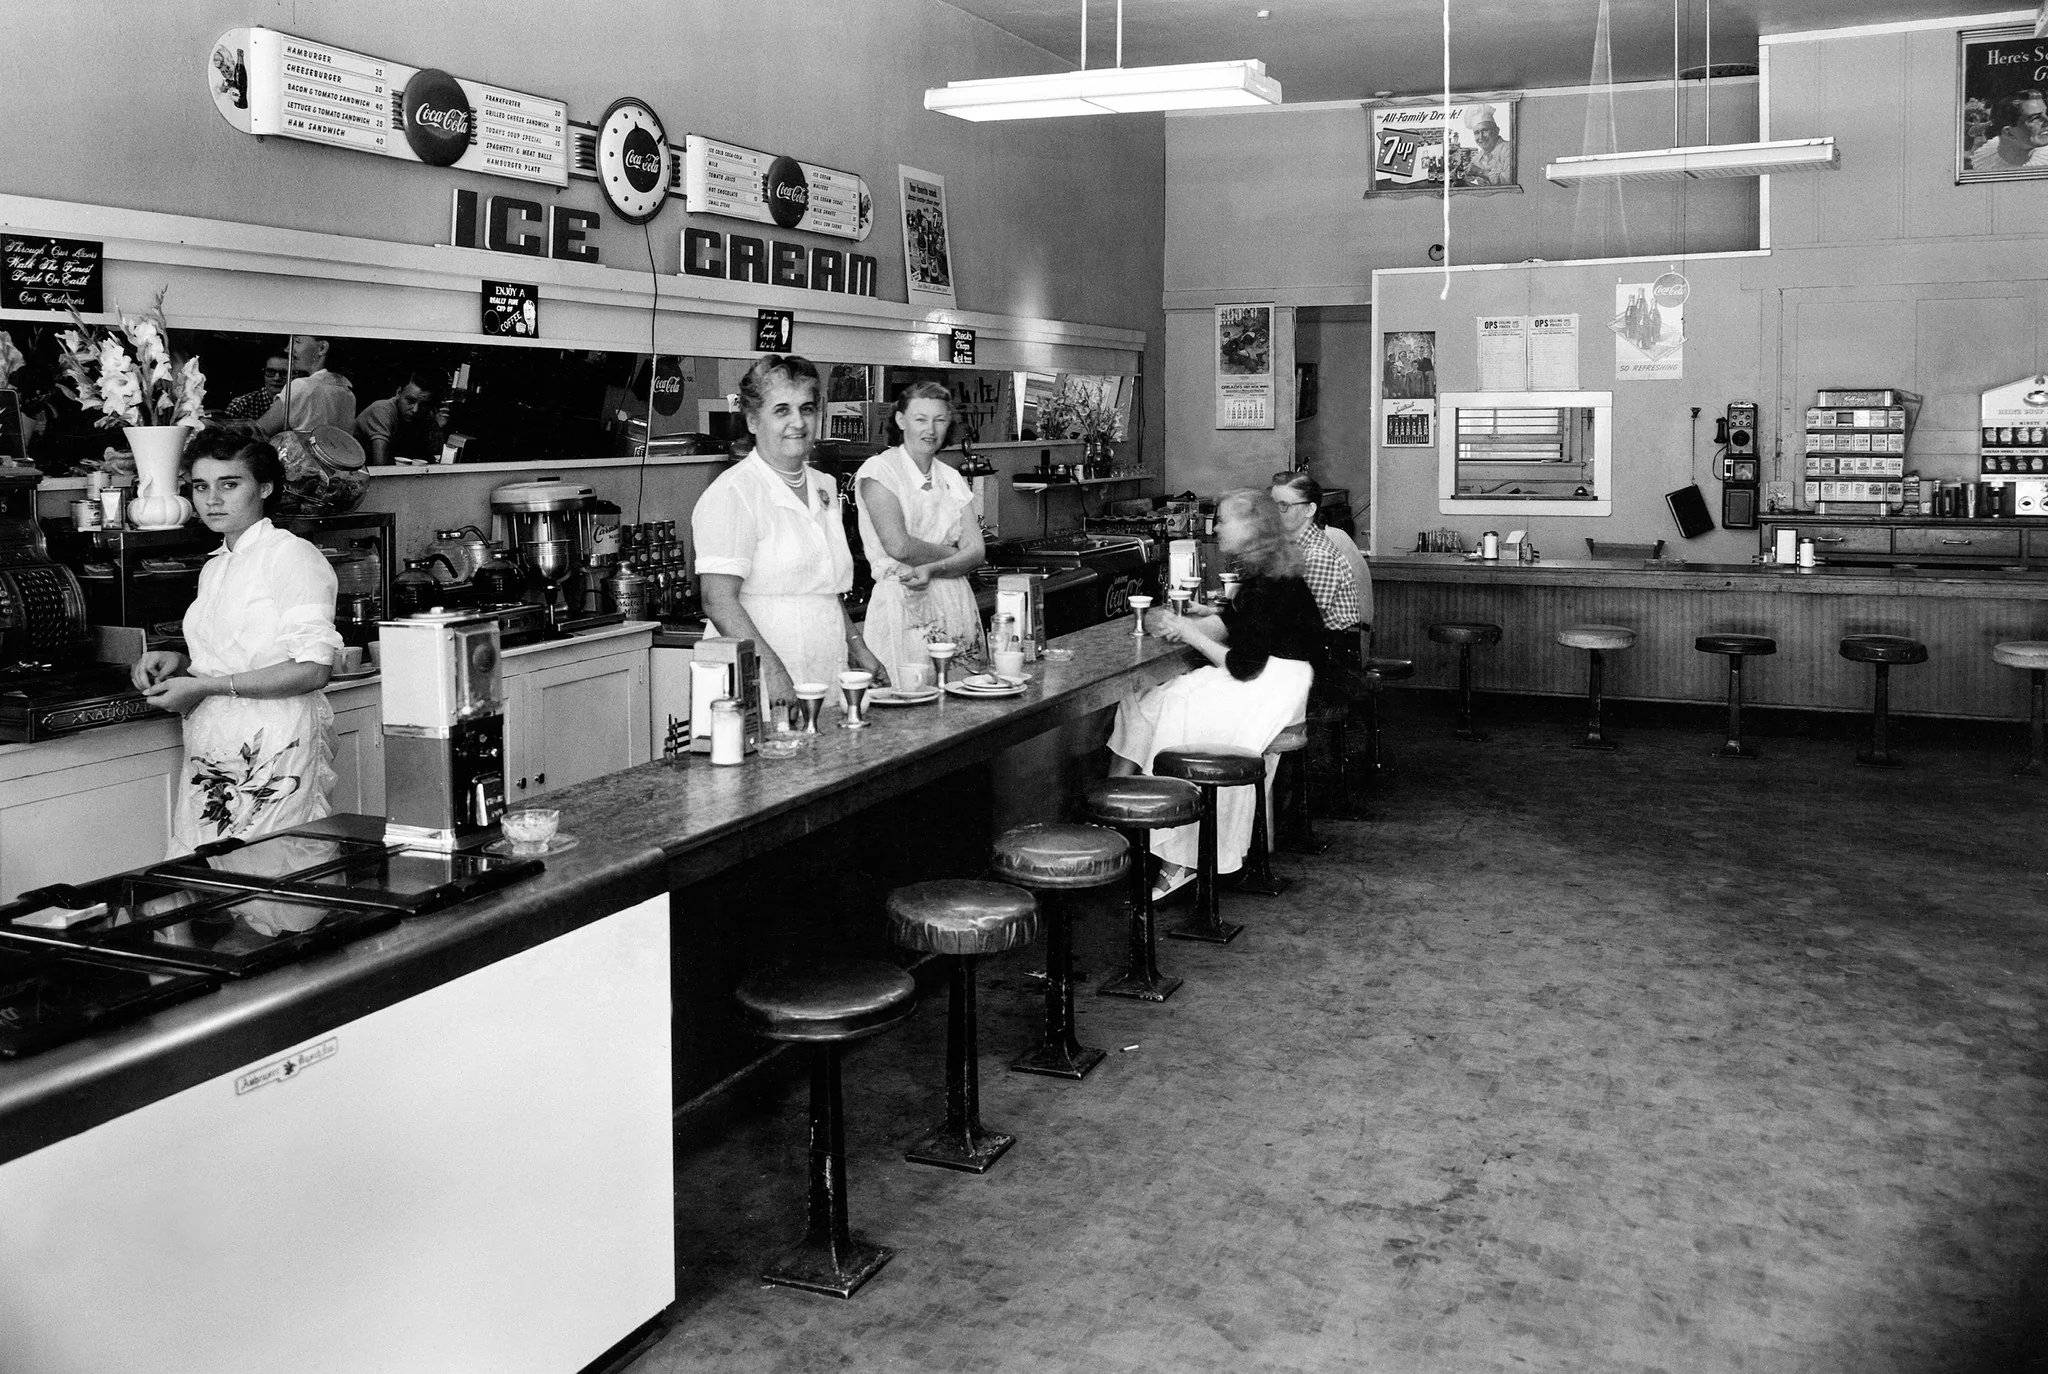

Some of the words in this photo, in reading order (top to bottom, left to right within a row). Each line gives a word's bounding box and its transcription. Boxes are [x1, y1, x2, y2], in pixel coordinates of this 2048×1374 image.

[287, 46, 332, 63] HAMBURGER
[376, 68, 382, 76] 25
[1988, 50, 2029, 66] Here's
[287, 64, 342, 83] CHEESEBURGER
[288, 83, 308, 93] BACON
[315, 90, 338, 100] TOMATO
[340, 95, 370, 107] SANDWICH
[486, 94, 521, 108] FRANKFURTER
[288, 102, 311, 111] LETTUCE
[318, 108, 340, 118] TOMATO
[342, 113, 370, 125] SANDWICH
[416, 103, 469, 134] Coca-Cola
[486, 110, 505, 119] GRILLED
[507, 114, 525, 123] CHEESE
[526, 118, 550, 128] SANDWICH
[1382, 111, 1429, 124] All-Family
[1430, 109, 1463, 120] Drik!
[288, 119, 304, 128] HAM
[308, 123, 346, 136] SANDWICH
[508, 130, 520, 139] SOUP
[522, 134, 542, 144] SPECIAL
[486, 143, 514, 153] SPAGHETTI
[522, 149, 536, 159] MEAT
[538, 152, 552, 161] BALLS
[486, 158, 522, 170] HAMBURGER
[524, 165, 541, 174] PLATE
[708, 172, 724, 180] TOMATO
[717, 189, 738, 198] CHOCOLATE
[451, 189, 600, 263] ICE
[680, 227, 878, 297] CREAM
[51, 246, 69, 259] Our
[7, 256, 37, 269] Walk
[39, 257, 59, 270] The
[45, 273, 60, 286] On
[62, 272, 91, 286] Earth
[19, 291, 37, 304] Our
[496, 286, 518, 297] ENJOY
[519, 289, 526, 298] A
[1654, 285, 1686, 296] Coca-Cola
[501, 311, 522, 332] COFFEE
[1485, 321, 1498, 329] OPS
[1535, 320, 1549, 328] OPS
